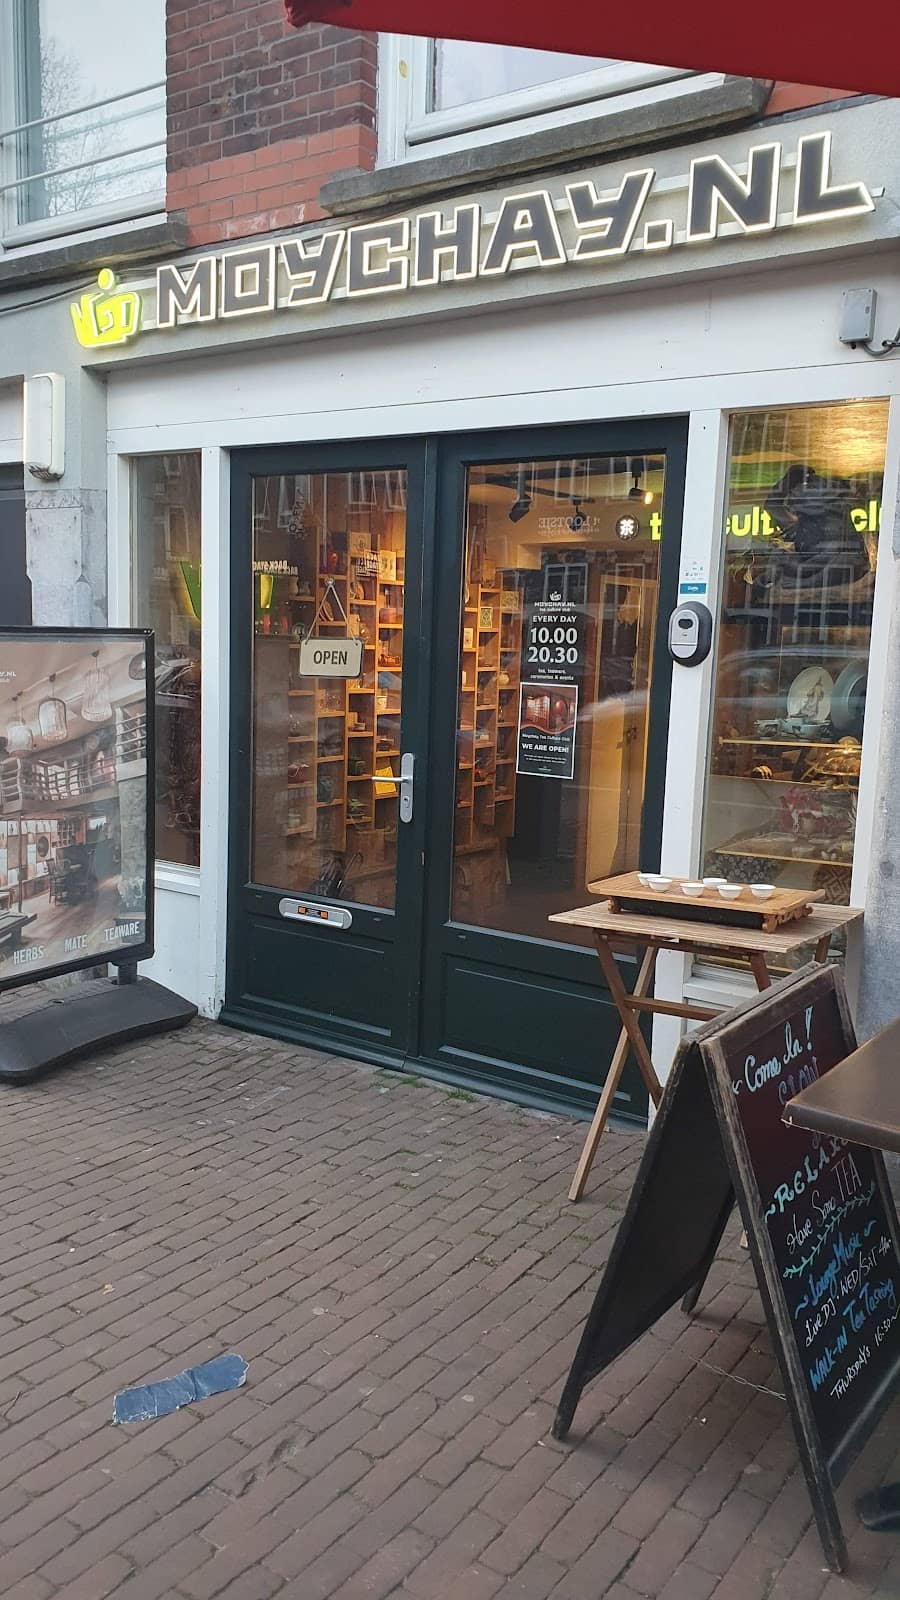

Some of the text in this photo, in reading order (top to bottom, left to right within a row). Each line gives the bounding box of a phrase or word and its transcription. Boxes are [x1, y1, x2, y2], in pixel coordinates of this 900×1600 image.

[156, 130, 876, 329] MOYCHAY.NL
[532, 615, 577, 623] EVERY DAY
[530, 627, 578, 644] 10.00
[313, 650, 348, 665] OPEN
[528, 646, 578, 664] 20.30
[534, 744, 548, 752] ARE
[549, 745, 570, 753] OPEN!
[13, 921, 140, 965] HERBS MATE TEAWARE
[744, 1055, 782, 1093] Come
[786, 1213, 813, 1255] Have
[830, 1152, 862, 1201] TEA
